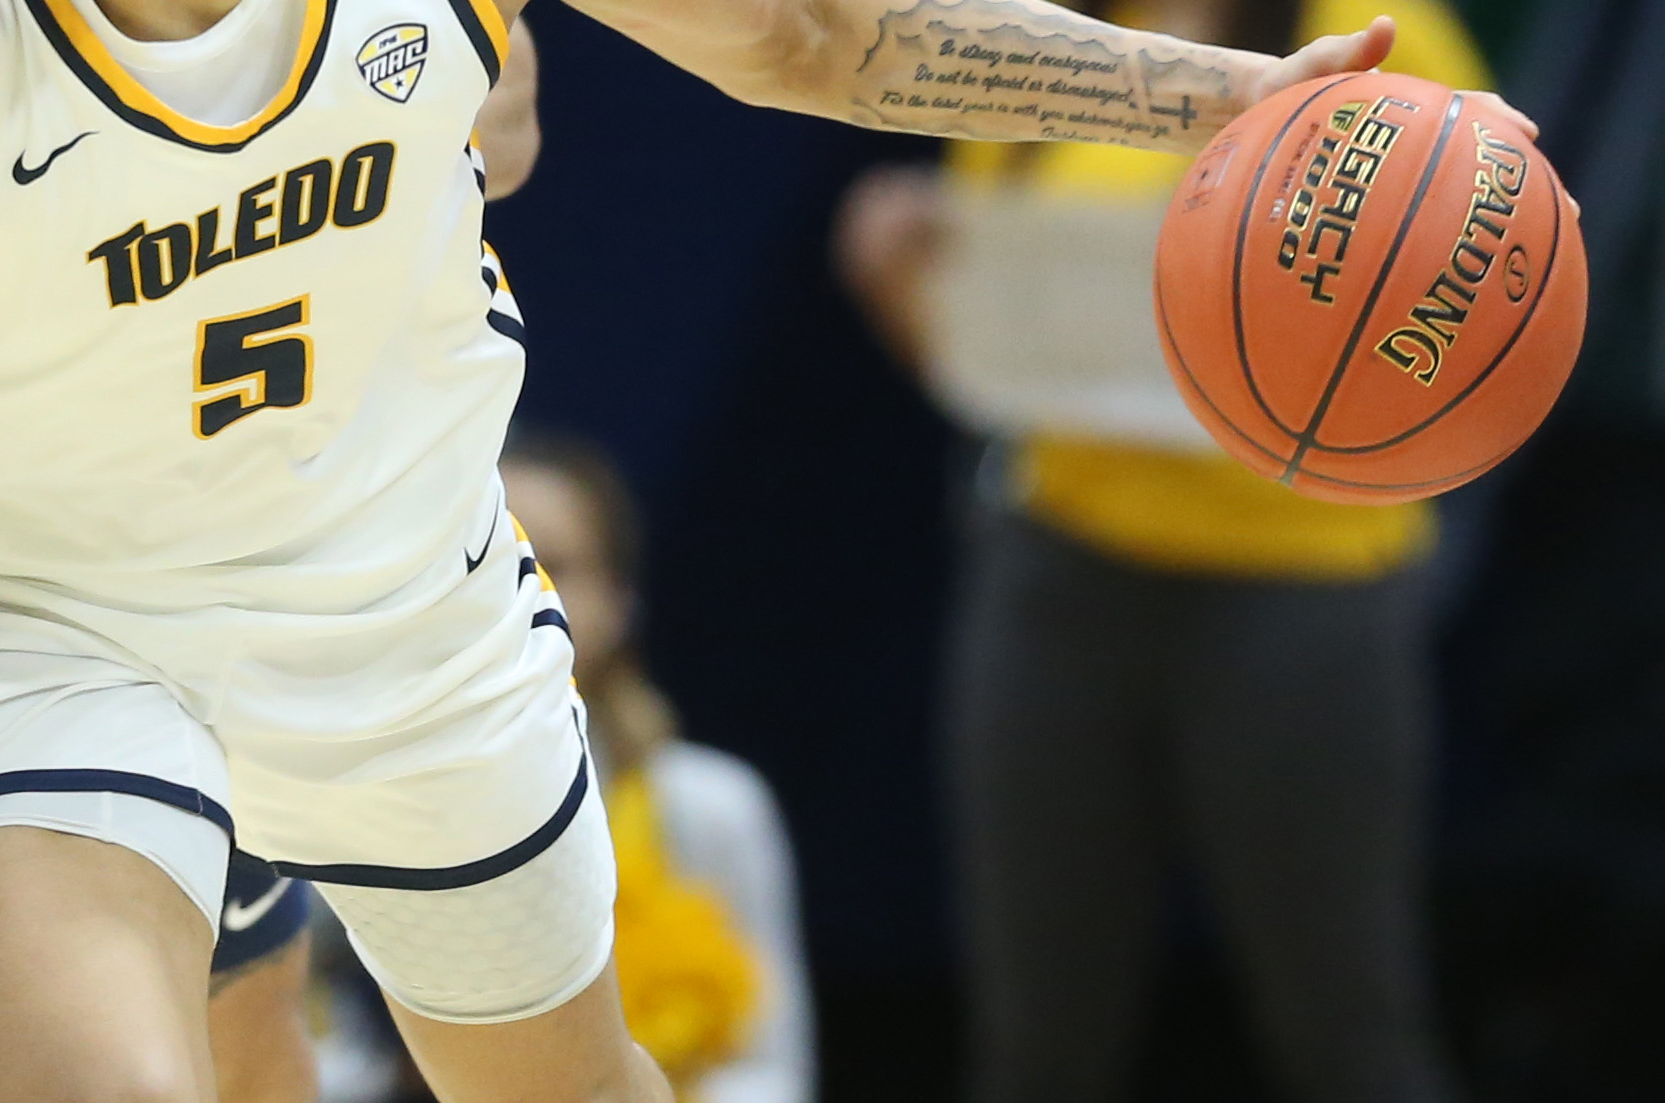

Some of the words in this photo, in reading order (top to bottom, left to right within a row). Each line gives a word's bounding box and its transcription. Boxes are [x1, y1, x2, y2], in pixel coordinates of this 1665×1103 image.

[363, 40, 427, 86] MAC
[914, 63, 934, 81] Do
[936, 71, 962, 84] not
[1006, 51, 1040, 65] and
[85, 140, 398, 308] TOLEDO
[1277, 137, 1339, 272] 1000
[1300, 96, 1421, 306] LEGACY
[1373, 120, 1530, 388] SPALDING
[192, 293, 314, 440] 5
